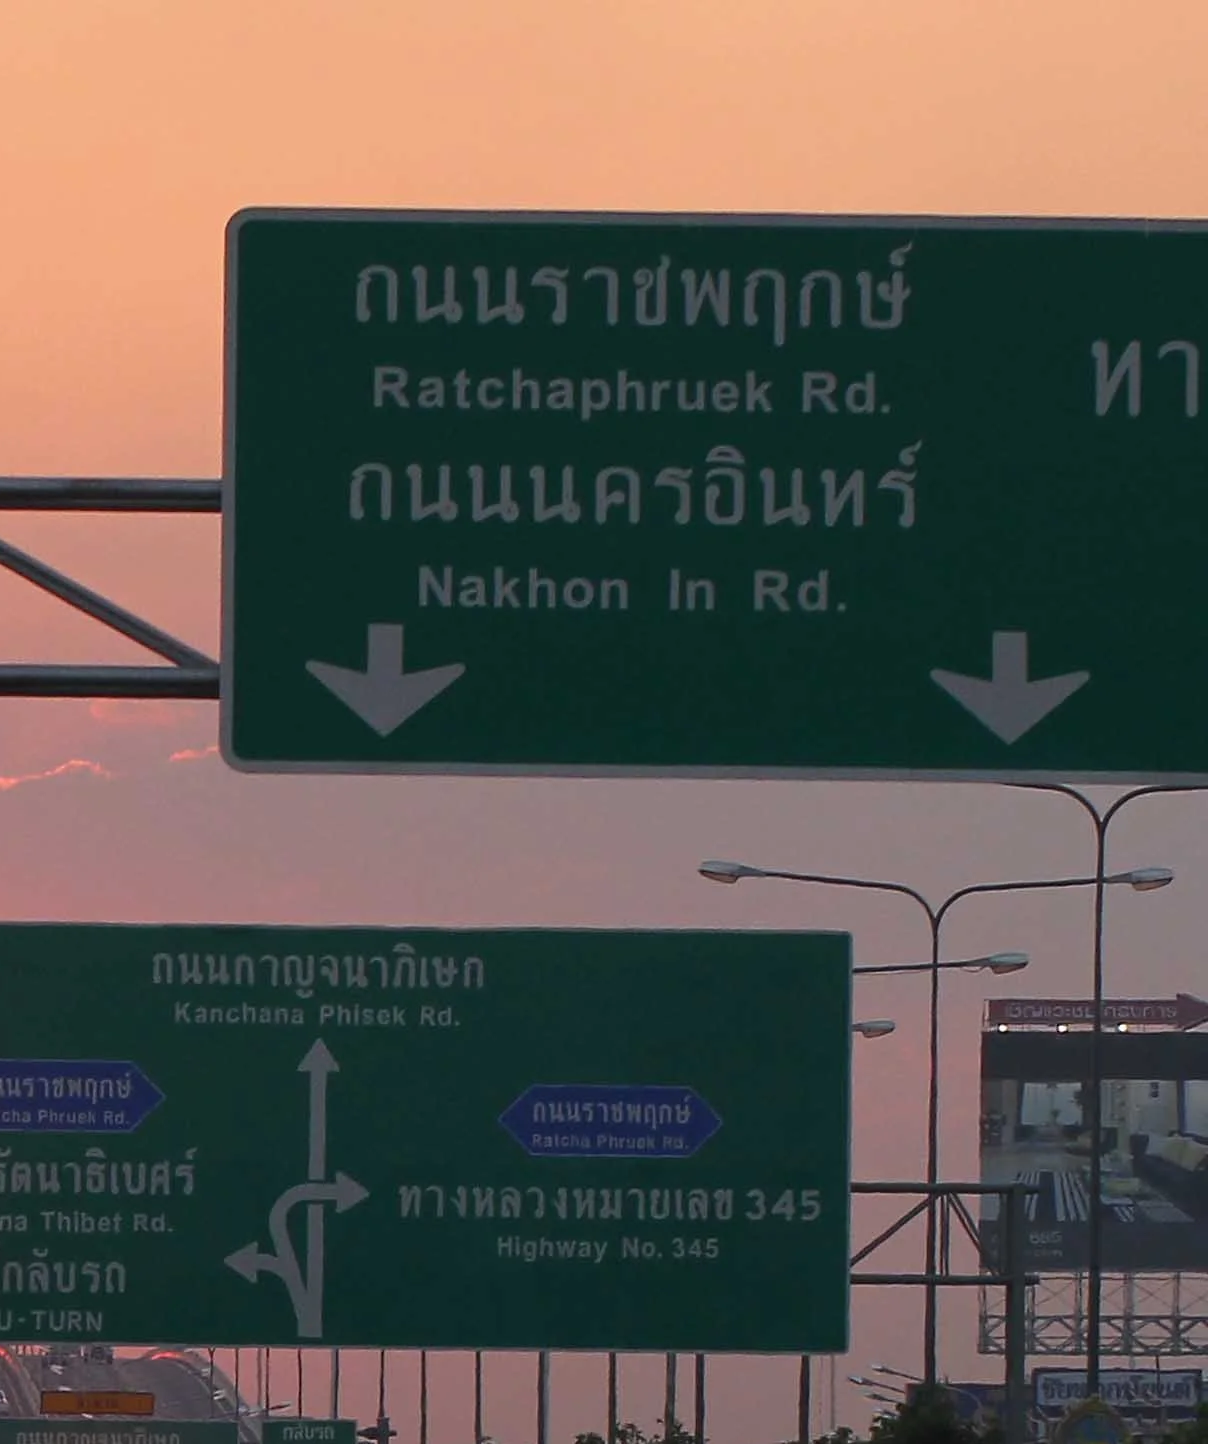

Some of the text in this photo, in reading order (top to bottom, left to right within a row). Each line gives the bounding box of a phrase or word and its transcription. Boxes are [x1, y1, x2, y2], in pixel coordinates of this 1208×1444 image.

[356, 242, 913, 347] ถนนราชพฤกษ์
[373, 366, 890, 421] Ratchaphruek Rd.
[1091, 340, 1200, 418] ทา
[349, 440, 922, 529] ถนนนครอินทร์
[418, 565, 846, 612] Nakhon In Rd.
[152, 942, 484, 999] ถนนกาญจนาภิเษก
[174, 1001, 460, 1027] Kanchana Phisek Rd.
[37, 1109, 96, 1125] Phruek
[103, 1110, 129, 1125] Rd.
[533, 1095, 691, 1130] ถนนราชพฤกษ์
[532, 1133, 591, 1149] Ratcha
[662, 1135, 689, 1150] Rd.
[398, 1185, 821, 1221] ทางหลวงหมายเลข 345
[40, 1210, 123, 1233] Thibet
[133, 1213, 174, 1233] Rd.
[497, 1235, 719, 1264] Highway No. 345
